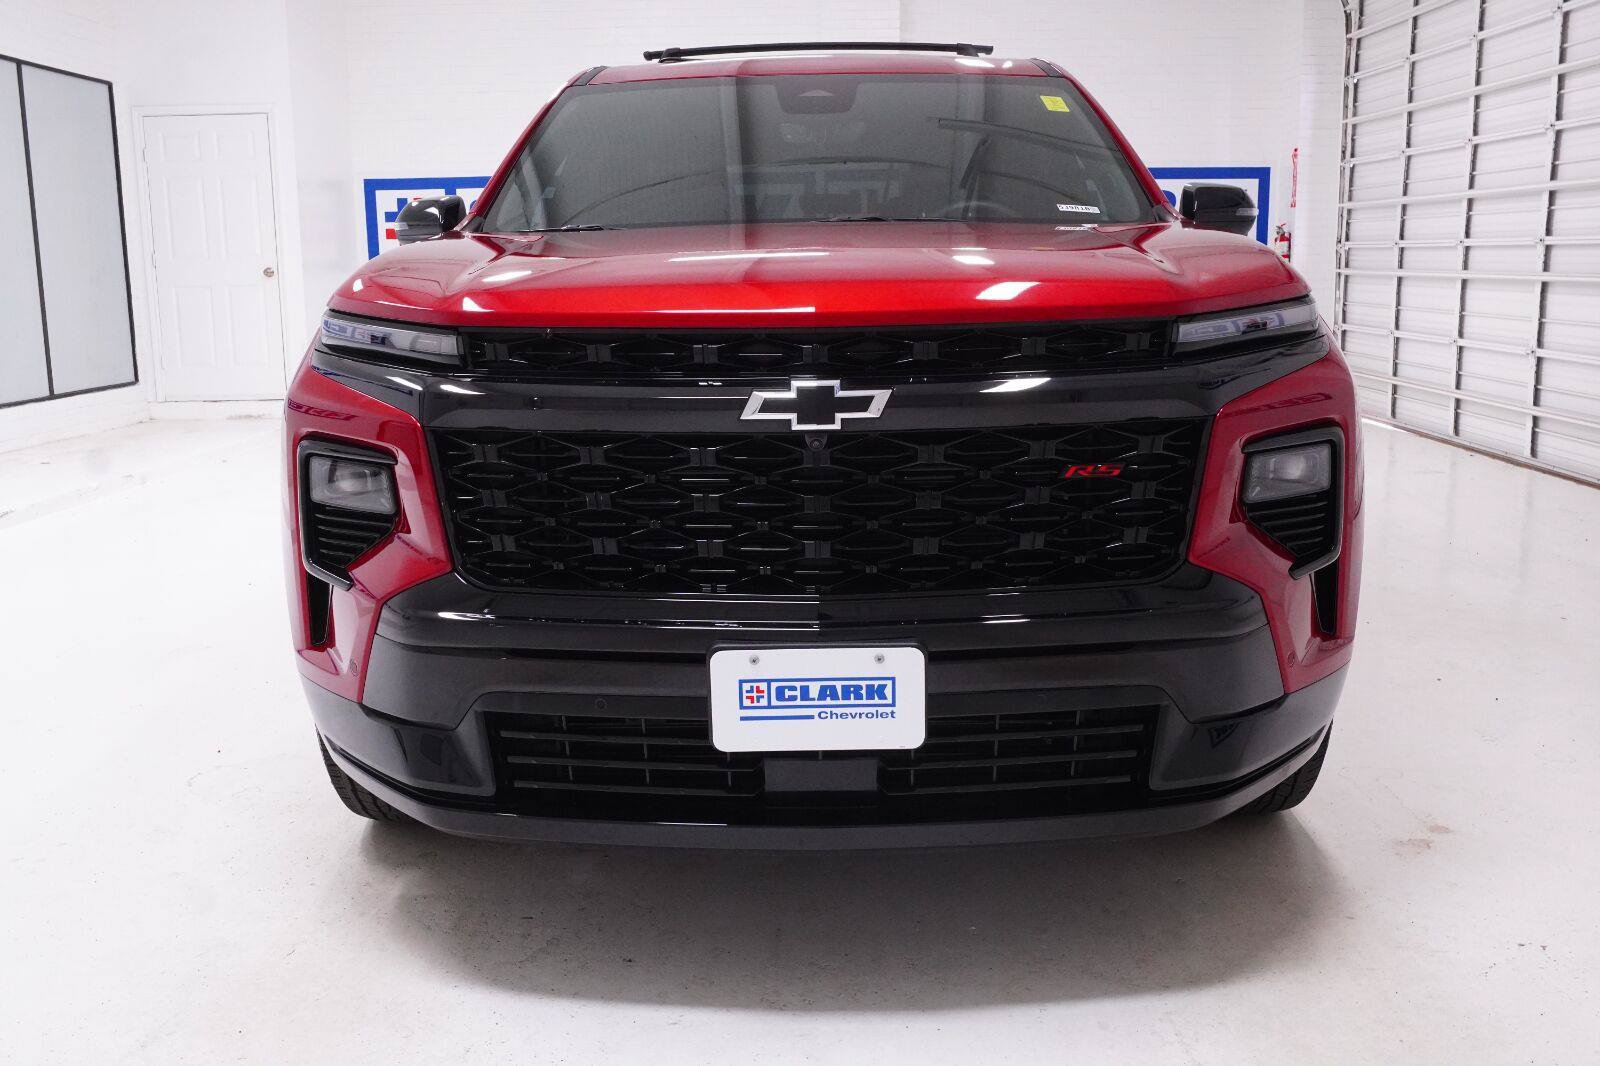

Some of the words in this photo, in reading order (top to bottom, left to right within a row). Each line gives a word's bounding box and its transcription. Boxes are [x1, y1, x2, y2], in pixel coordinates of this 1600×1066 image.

[1064, 465, 1121, 479] RS
[775, 684, 888, 702] CLARK
[817, 710, 896, 720] Chevrolet
